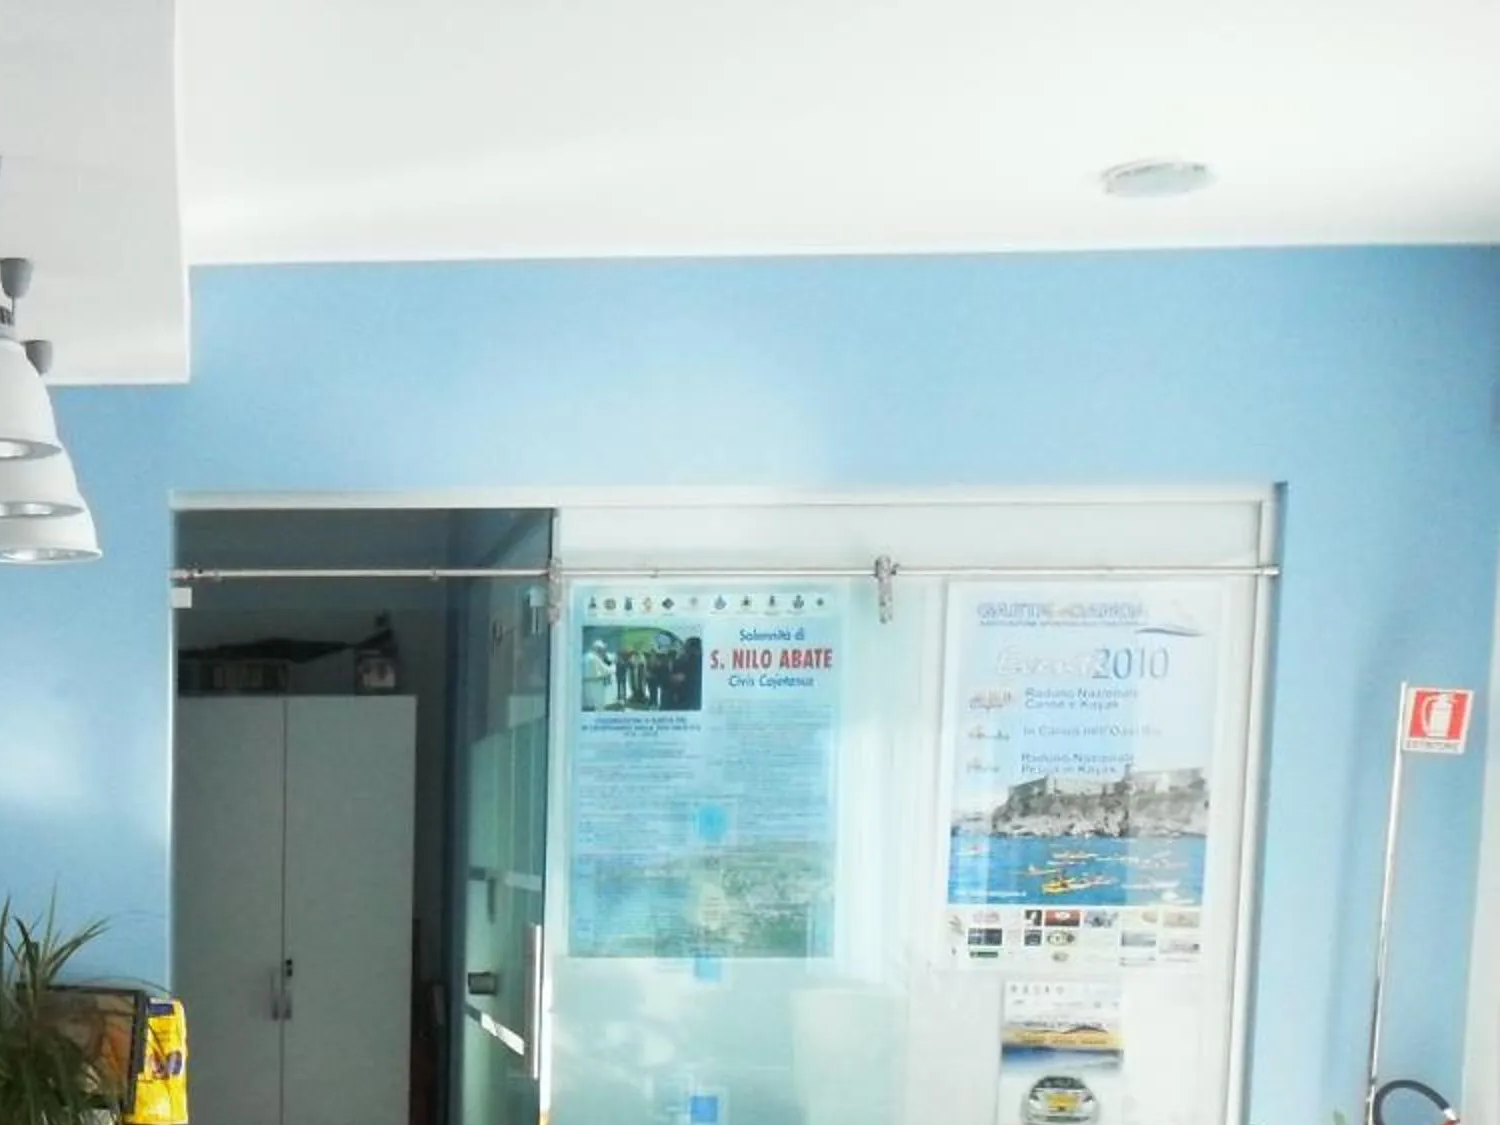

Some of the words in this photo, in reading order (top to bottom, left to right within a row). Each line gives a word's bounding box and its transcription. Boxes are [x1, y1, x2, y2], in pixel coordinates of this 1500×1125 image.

[710, 649, 725, 670] S.
[732, 648, 772, 669] NILO
[780, 648, 833, 669] ABATE
[1092, 647, 1170, 680] 2010
